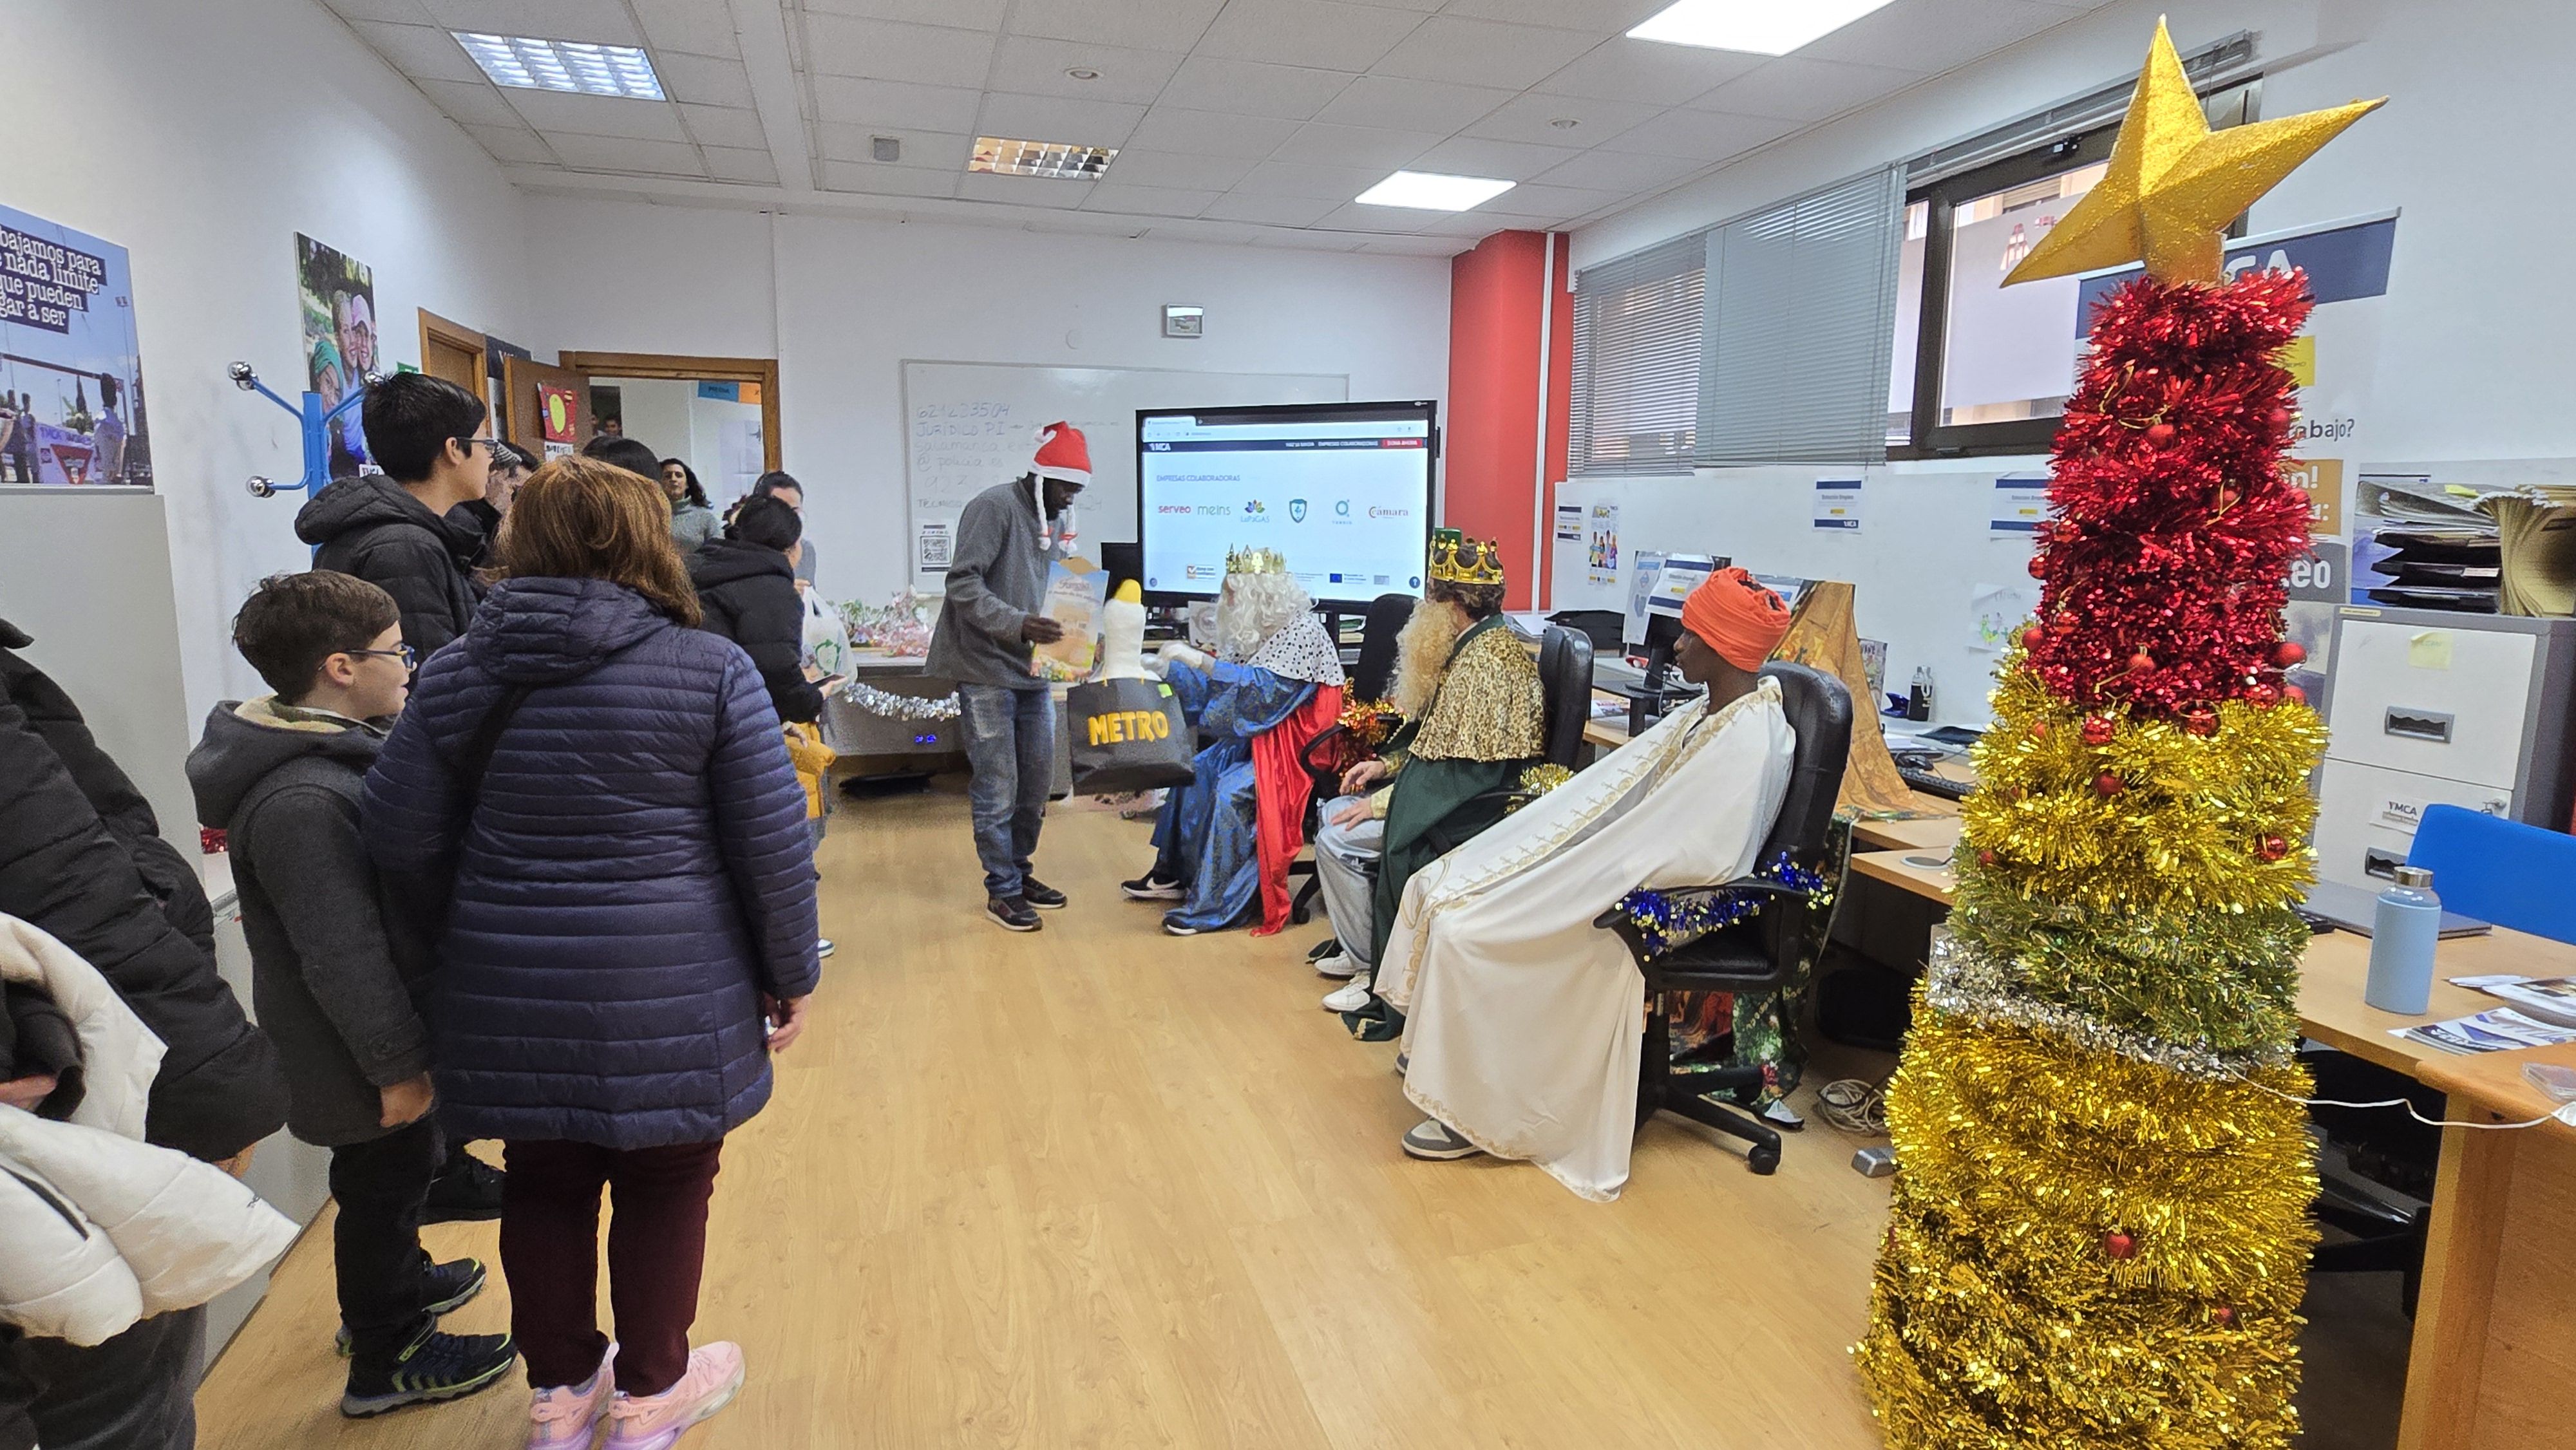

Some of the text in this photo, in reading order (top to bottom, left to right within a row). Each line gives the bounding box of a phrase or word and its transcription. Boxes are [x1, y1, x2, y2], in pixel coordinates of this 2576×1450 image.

[4, 252, 50, 281] nada
[51, 261, 99, 294] limite
[67, 252, 102, 276] para
[25, 281, 84, 310] pueden
[27, 303, 40, 321] a
[41, 306, 66, 326] ser
[1158, 505, 1191, 514] serveo
[1197, 504, 1231, 516] meins
[1087, 710, 1171, 746] METRO
